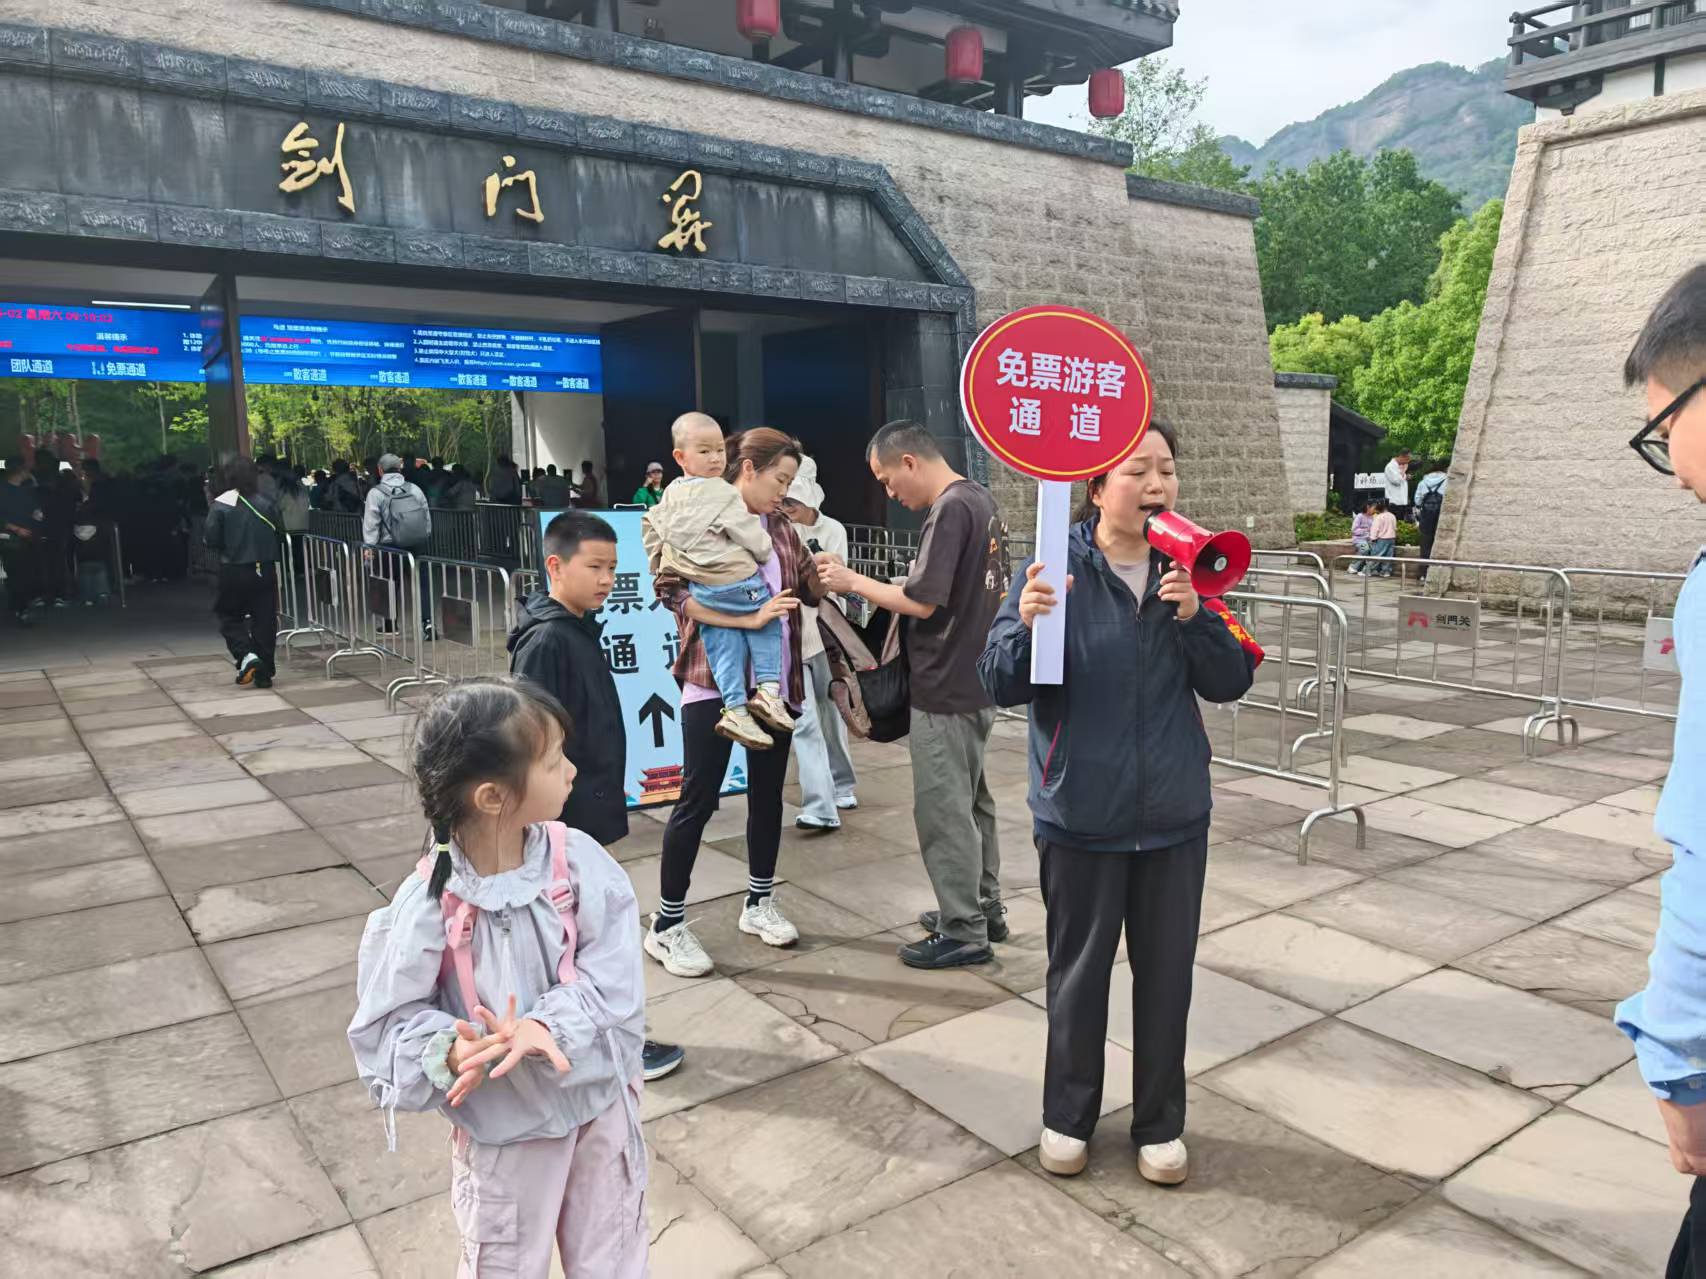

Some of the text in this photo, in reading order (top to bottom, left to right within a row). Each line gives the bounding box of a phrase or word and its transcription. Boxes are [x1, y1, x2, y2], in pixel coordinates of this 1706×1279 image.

[10, 358, 54, 374] 团队通道
[996, 348, 1127, 399] 免票游客
